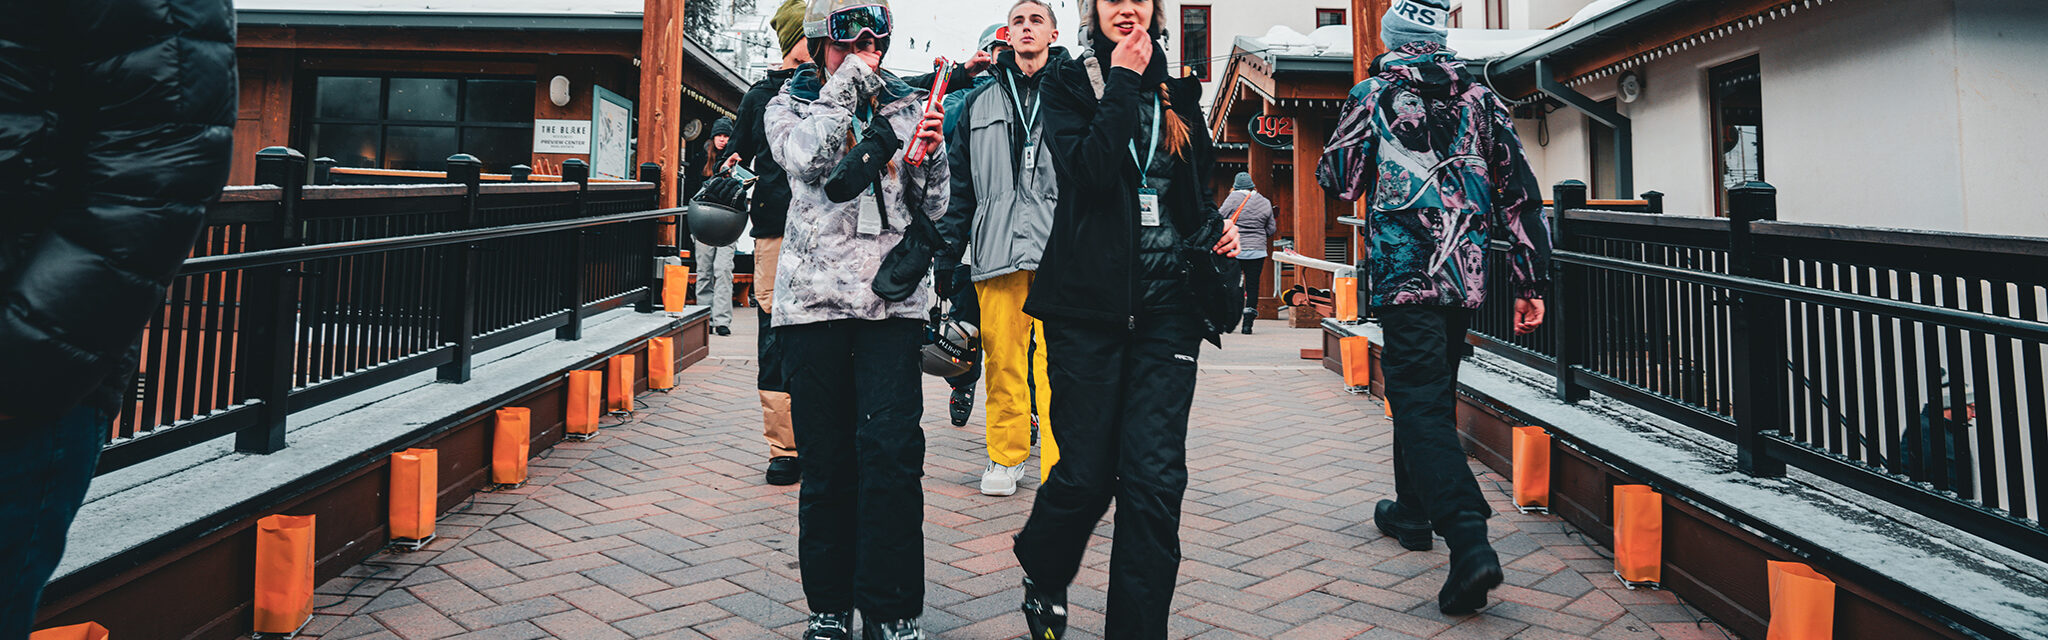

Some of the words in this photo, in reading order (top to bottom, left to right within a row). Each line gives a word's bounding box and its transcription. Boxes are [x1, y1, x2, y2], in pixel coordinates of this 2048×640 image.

[541, 125, 556, 134] THE
[560, 126, 586, 135] BLAKE
[1257, 116, 1294, 138] 192
[938, 339, 962, 356] SMITH
